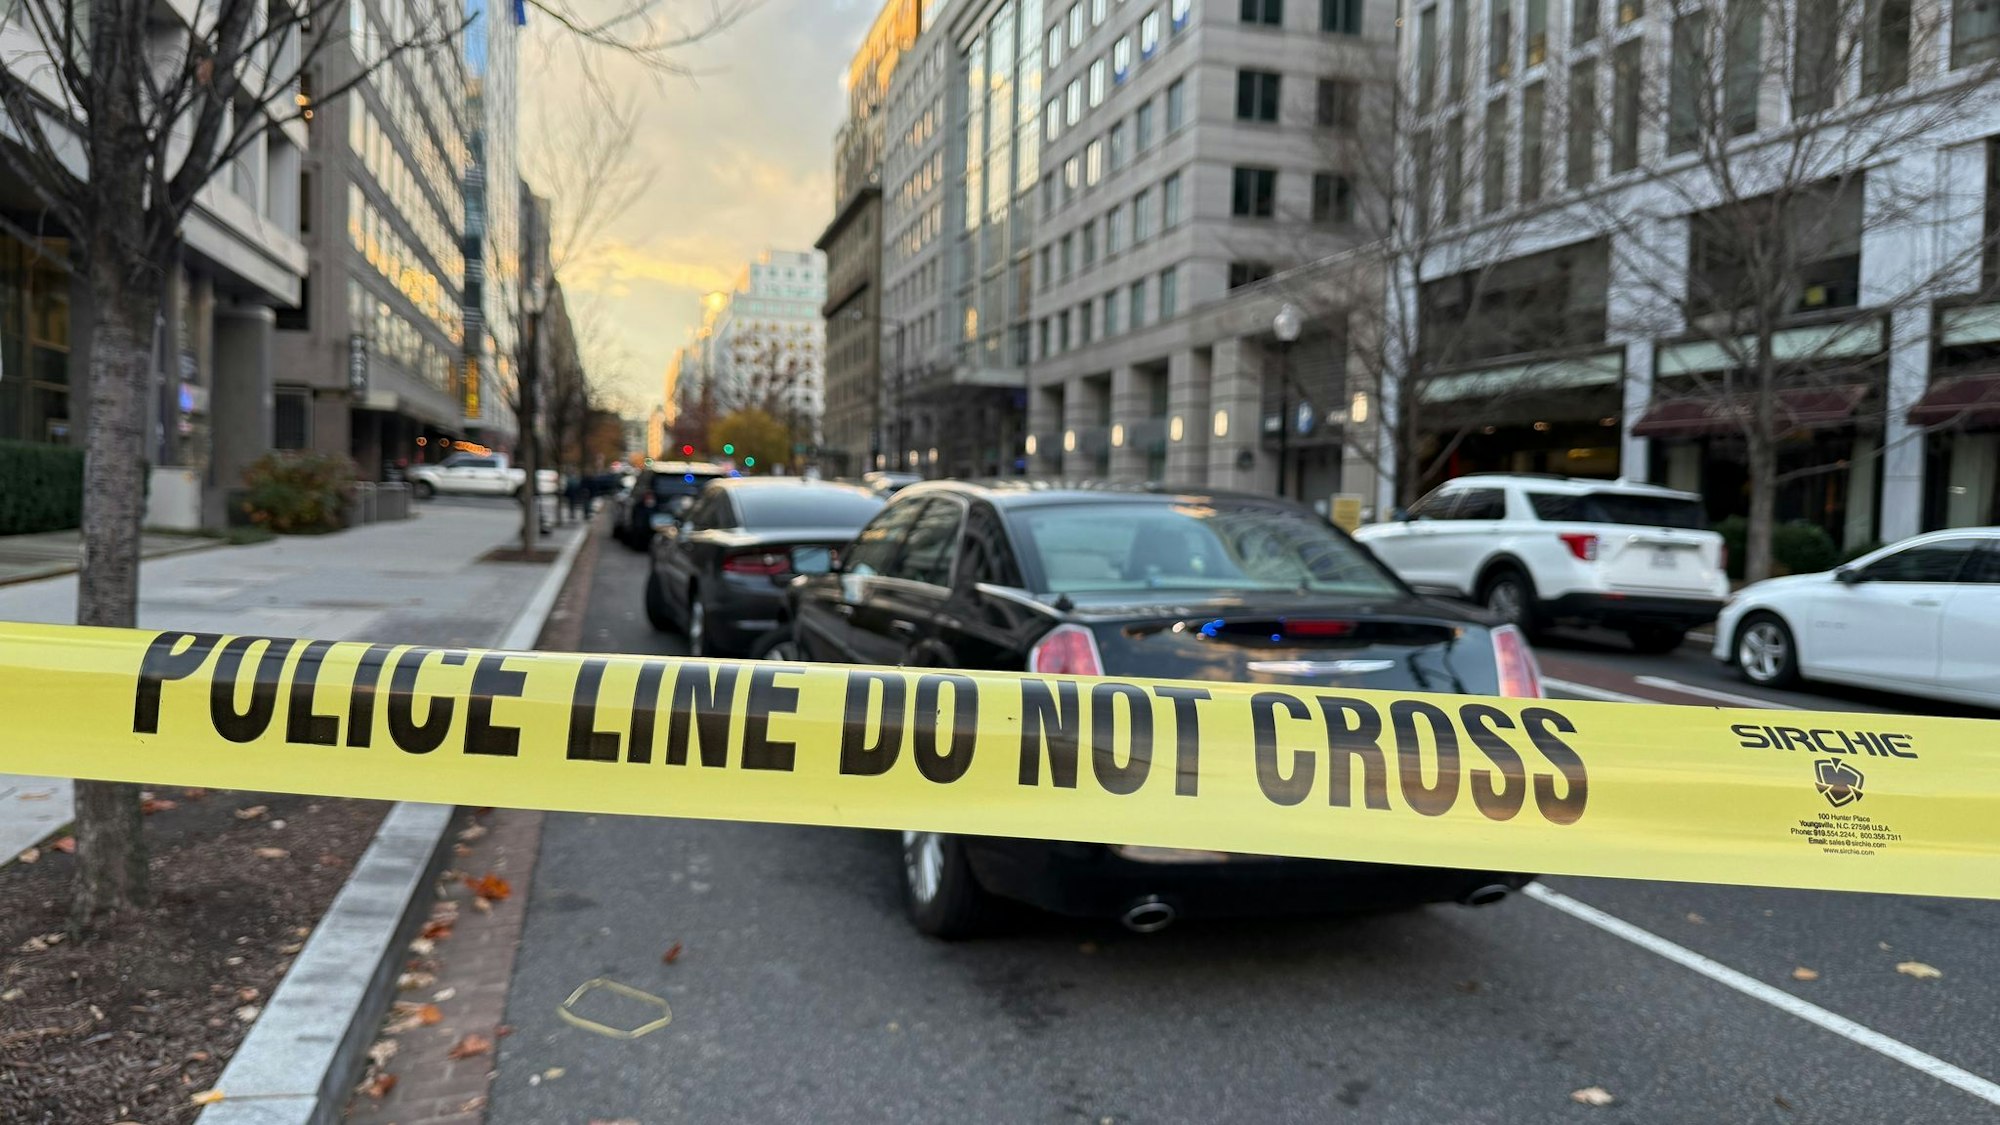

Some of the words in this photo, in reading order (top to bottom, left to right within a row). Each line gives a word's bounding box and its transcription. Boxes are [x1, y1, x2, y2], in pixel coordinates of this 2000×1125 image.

[133, 631, 536, 757] POLICE
[566, 657, 803, 771] LINE
[839, 668, 979, 784] DO
[1017, 677, 1212, 797] NOT
[1250, 691, 1588, 825] CROSS
[1730, 724, 1918, 759] SIRCHIE
[1799, 819, 1836, 829] Youngsville,
[1871, 824, 1891, 832] U.S.A.
[1790, 827, 1813, 836] Phone:
[1808, 837, 1828, 845] Email:
[1823, 847, 1875, 856] www.sirchie.com
